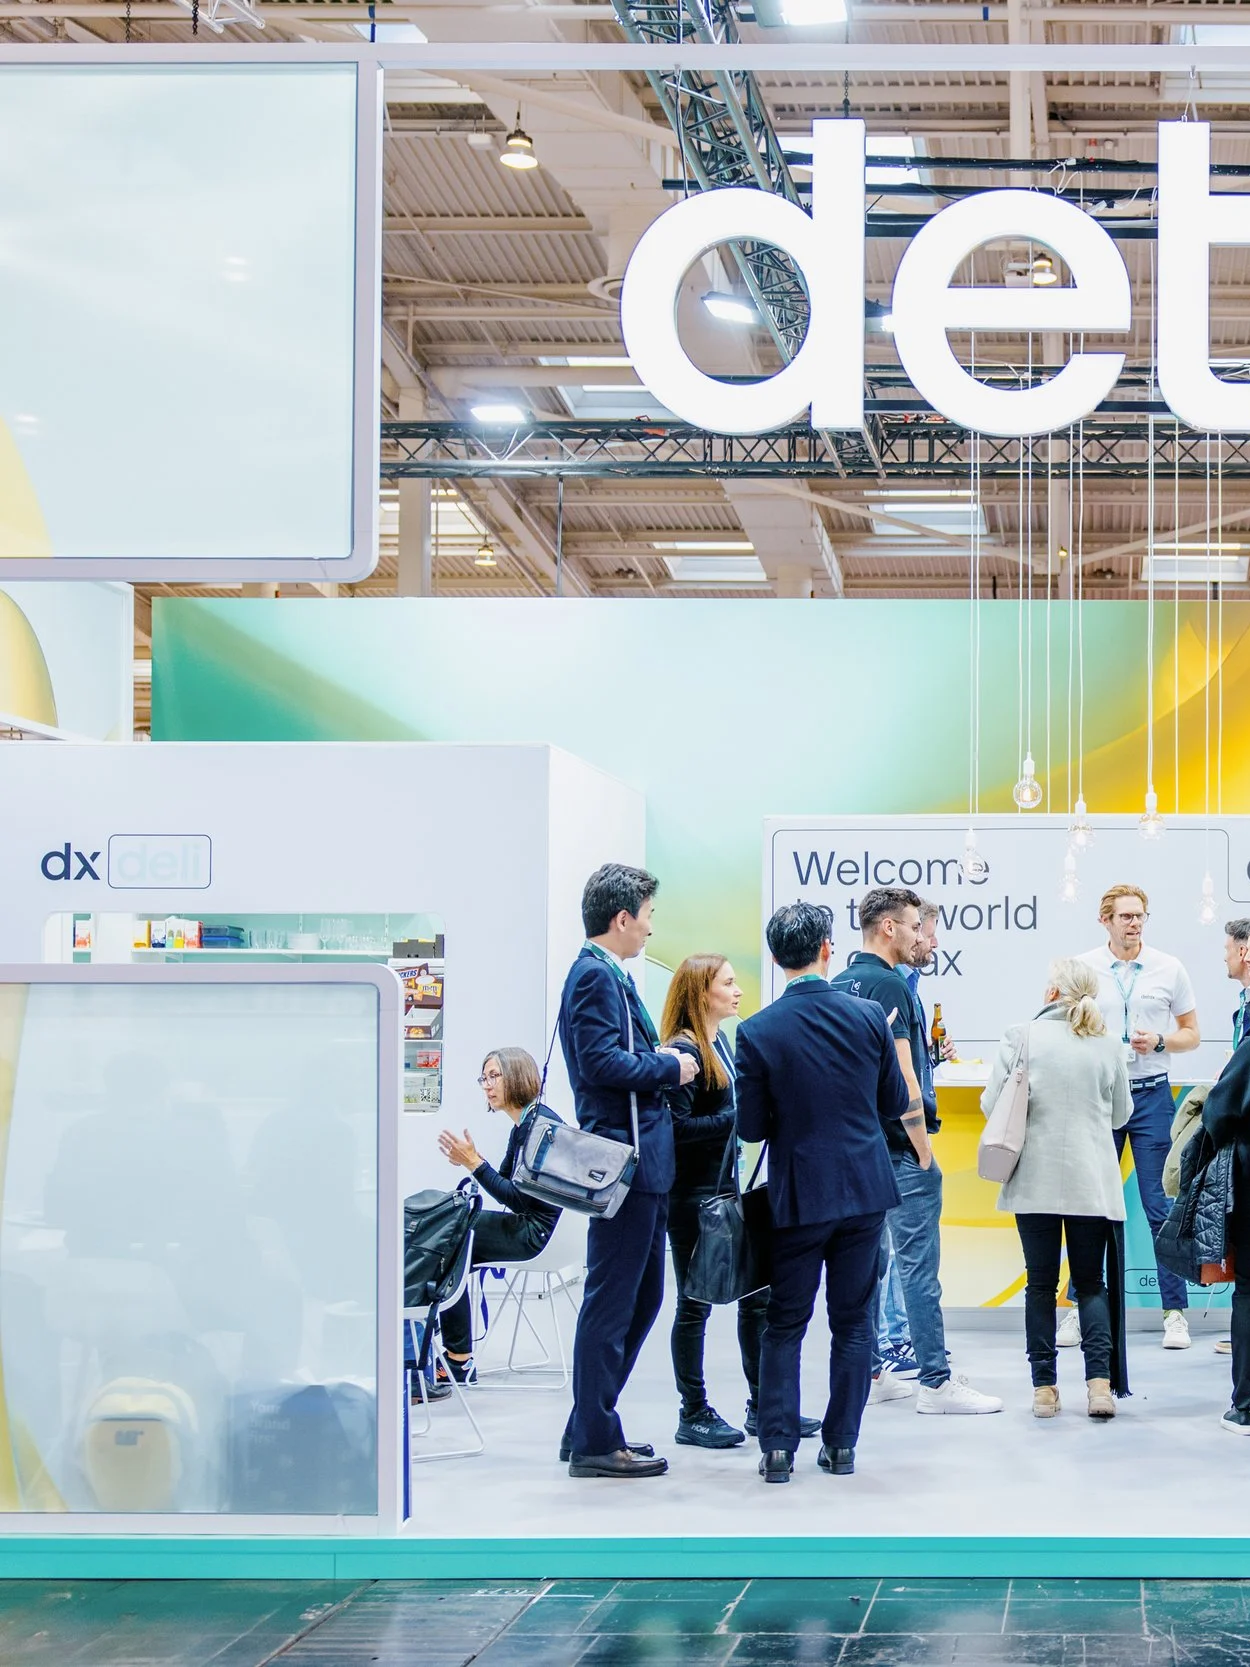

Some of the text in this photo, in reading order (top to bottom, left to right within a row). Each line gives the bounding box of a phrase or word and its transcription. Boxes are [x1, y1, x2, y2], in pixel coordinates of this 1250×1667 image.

[40, 842, 200, 882] dx deli
[792, 851, 990, 886] Welcome
[691, 1423, 710, 1435] HOKA
